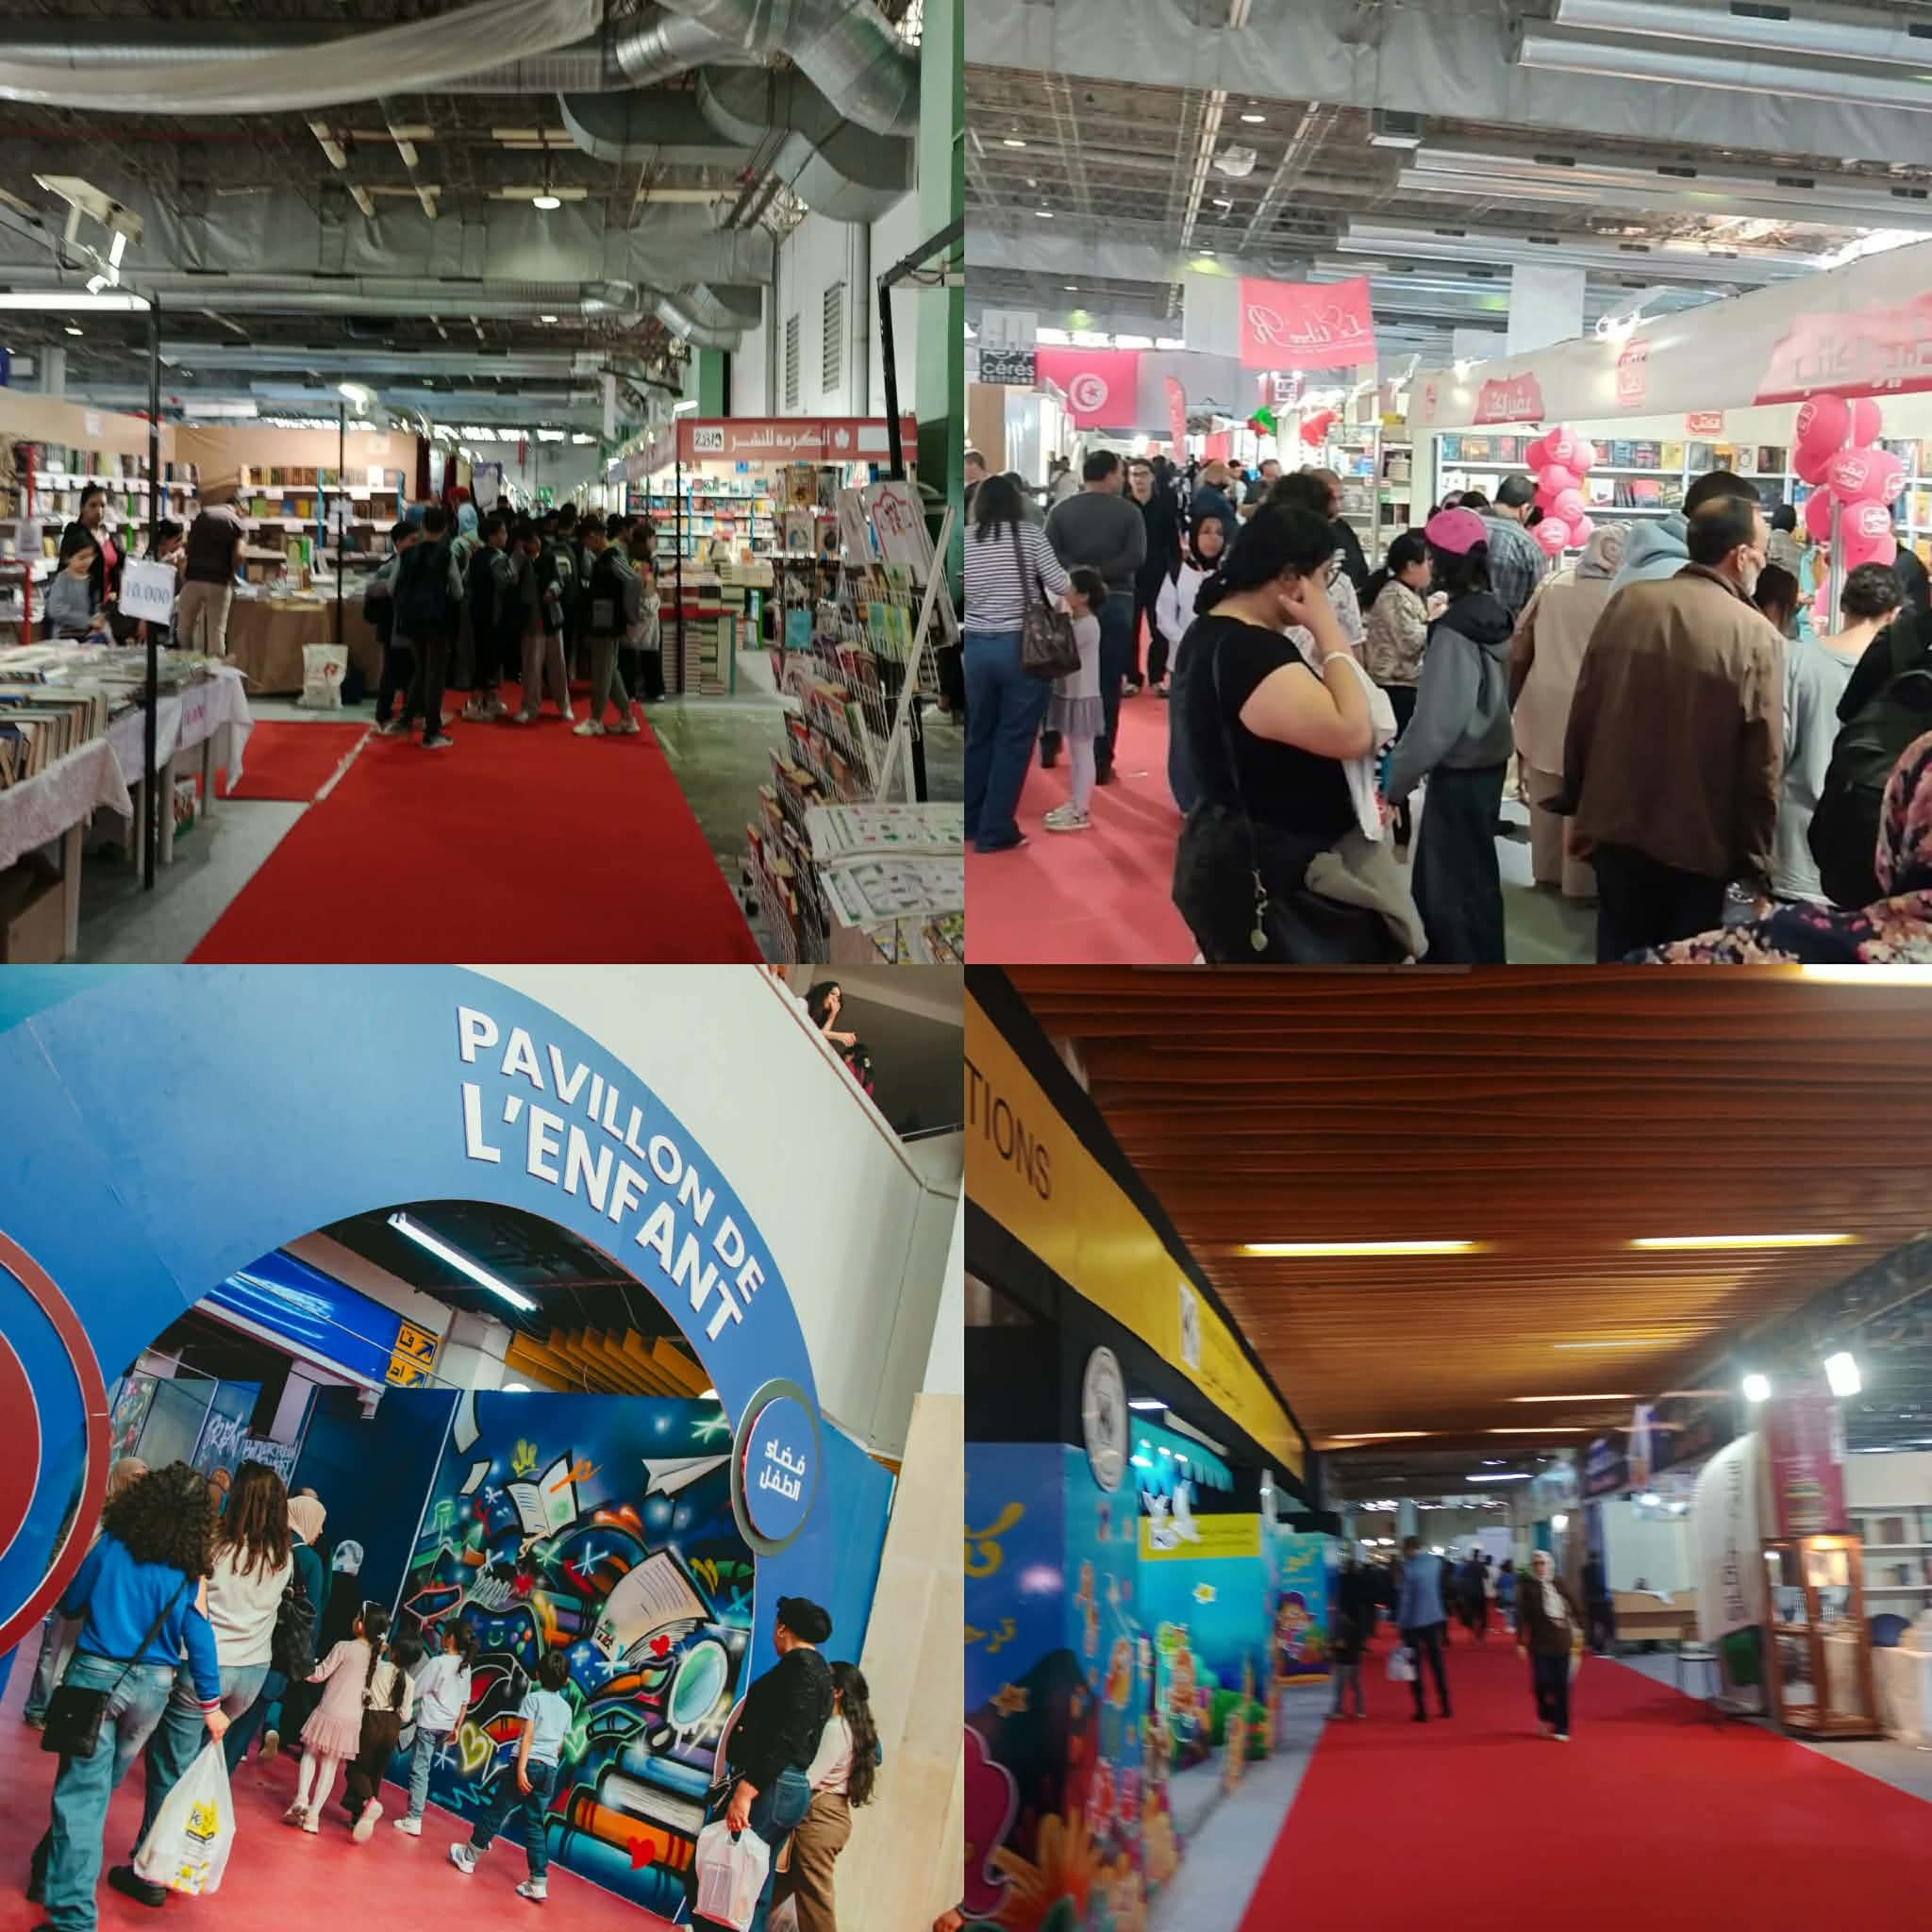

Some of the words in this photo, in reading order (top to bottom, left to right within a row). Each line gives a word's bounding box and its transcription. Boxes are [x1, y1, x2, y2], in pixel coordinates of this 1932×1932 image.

[458, 1006, 715, 1227] PAVILLON
[712, 1214, 765, 1305] DE
[463, 1082, 743, 1341] L'ENFANT
[758, 1464, 801, 1502] الطفل
[764, 1439, 807, 1475] فضاء
